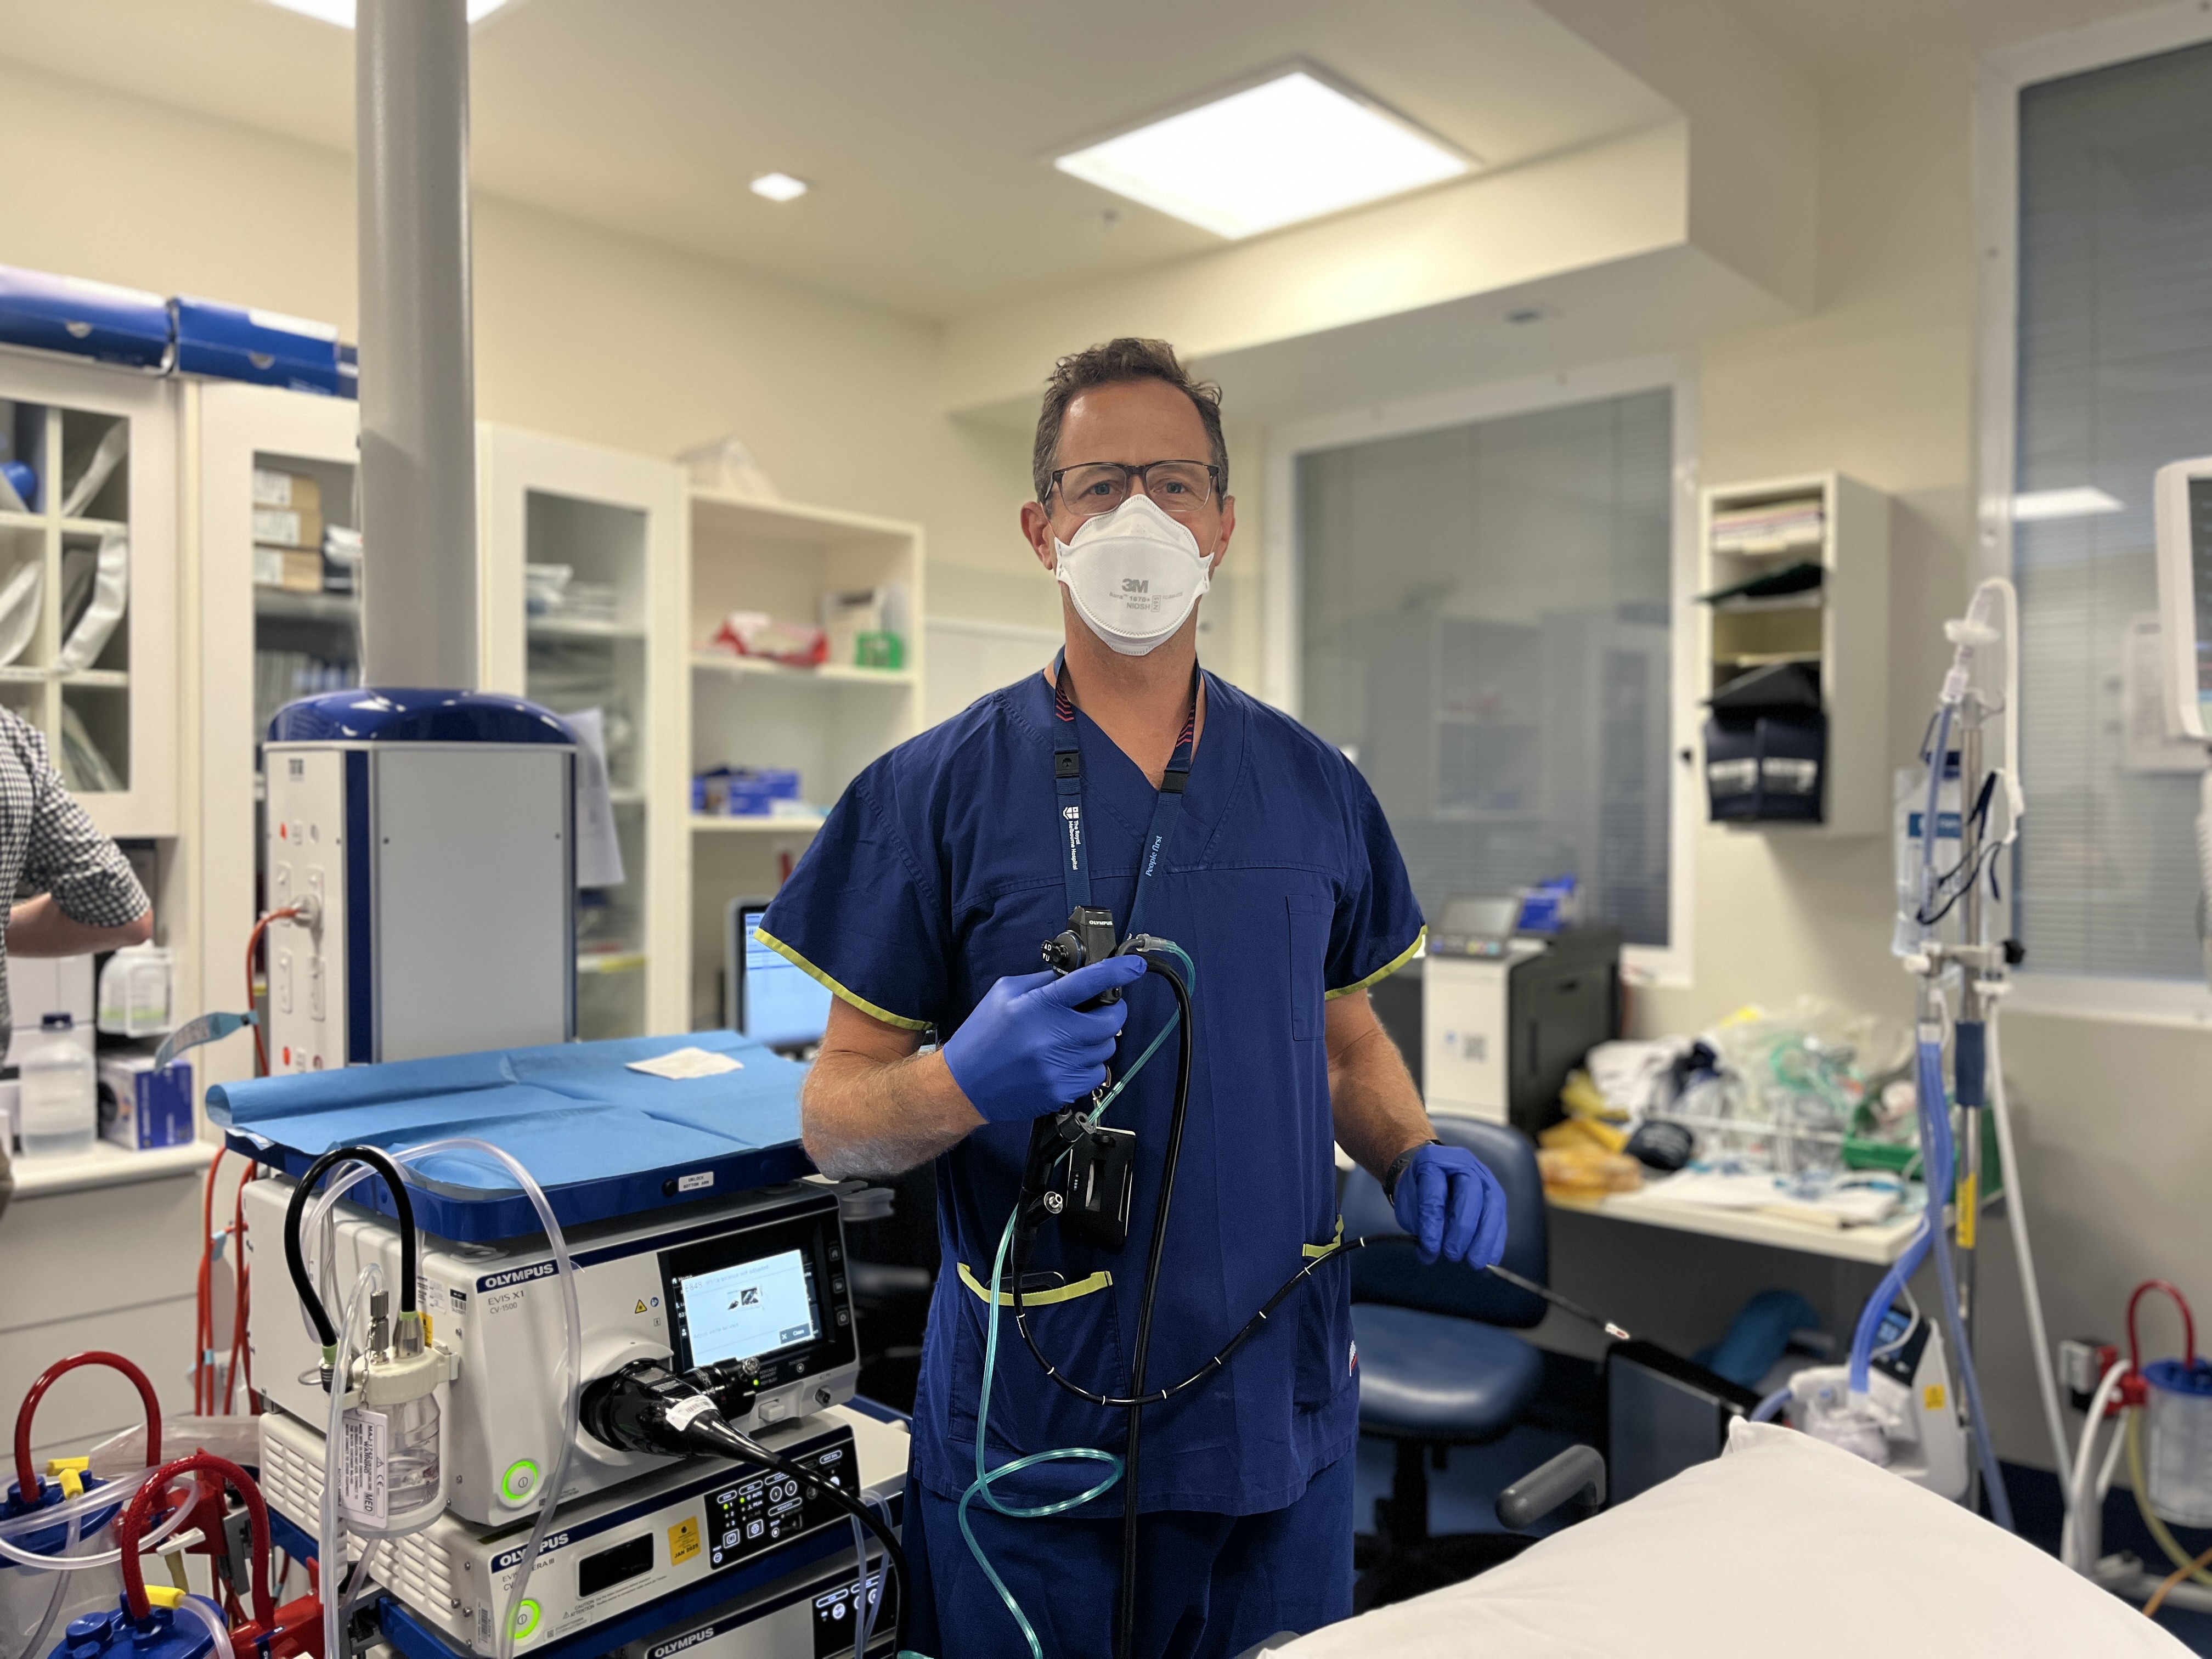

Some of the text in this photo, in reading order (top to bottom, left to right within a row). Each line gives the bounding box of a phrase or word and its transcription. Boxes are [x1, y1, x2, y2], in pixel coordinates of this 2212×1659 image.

[1121, 578, 1149, 594] 3M
[1126, 602, 1150, 611] NIOSH
[1070, 848, 1079, 870] Hospital
[1145, 835, 1163, 877] People first
[485, 1263, 554, 1288] OLYMPUS
[488, 1290, 524, 1306] EVIS X1
[489, 1302, 518, 1314] CV-1500
[365, 1493, 373, 1512] MED
[777, 1502, 793, 1511] MEMORY
[500, 1533, 569, 1566] OLYPUS
[674, 1549, 685, 1559] JAN
[571, 1604, 595, 1617] ATTENTION
[574, 1599, 595, 1610] CAUTION
[654, 1627, 714, 1657] OLYMPUS
